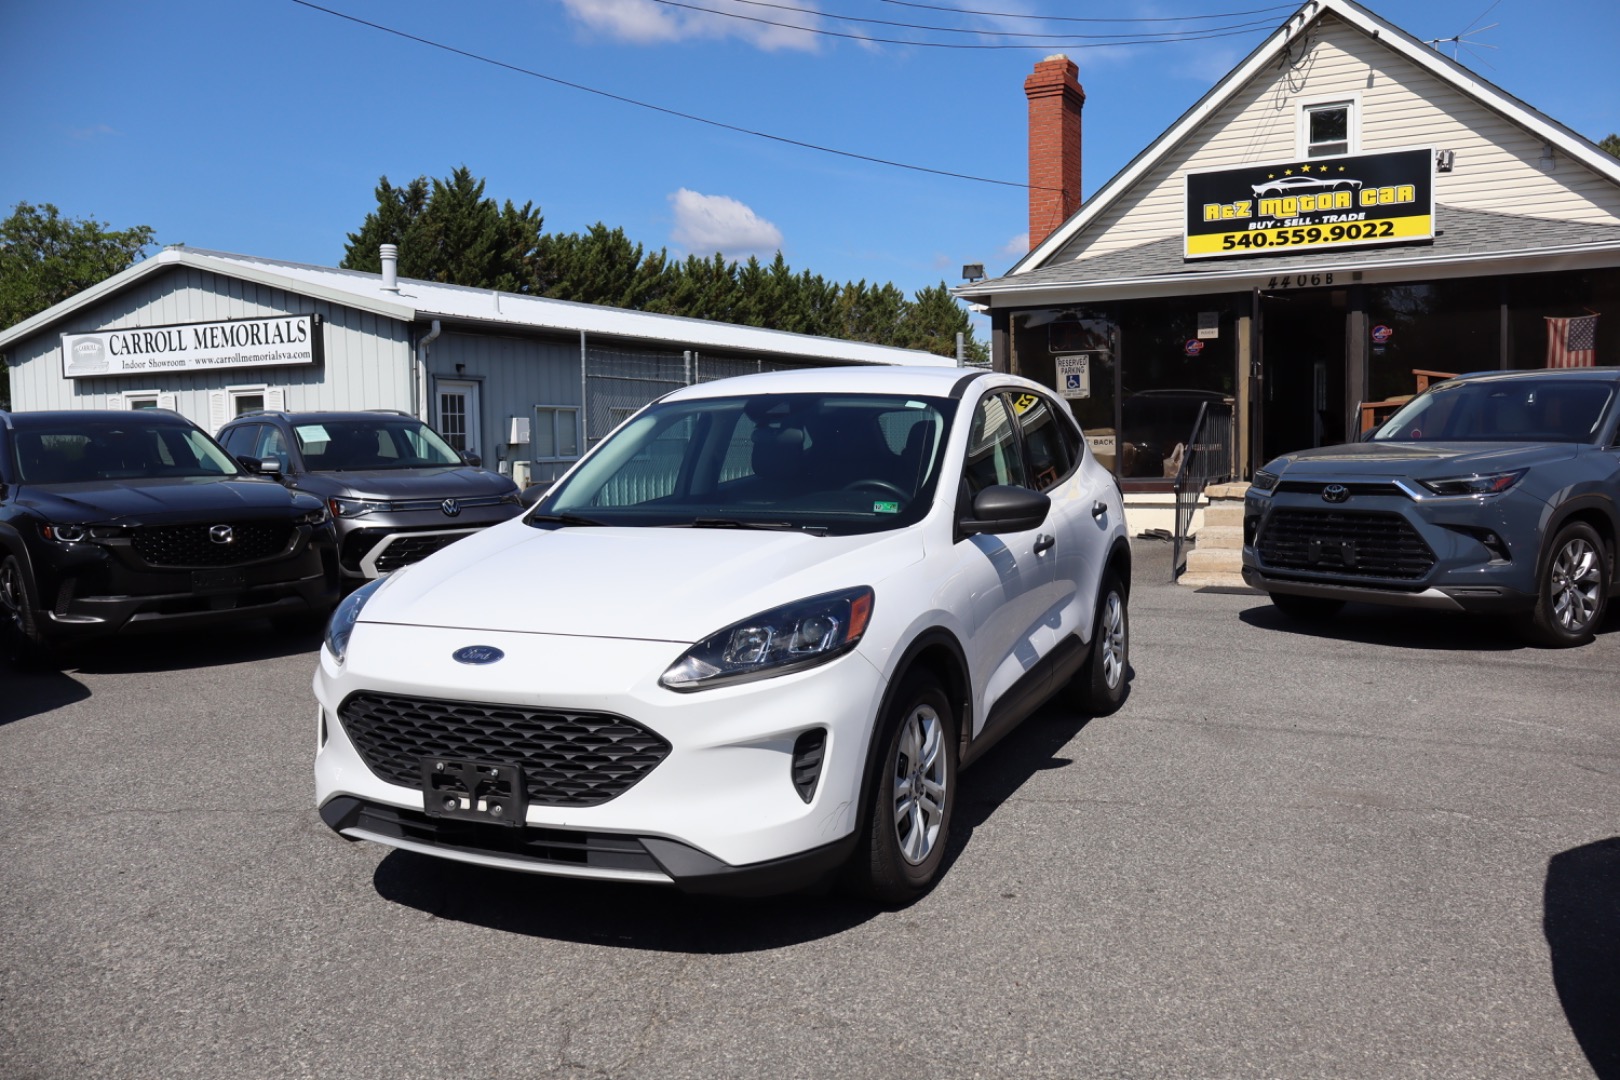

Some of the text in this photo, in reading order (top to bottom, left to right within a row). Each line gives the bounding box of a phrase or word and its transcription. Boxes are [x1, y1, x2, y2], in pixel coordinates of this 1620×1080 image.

[1203, 200, 1252, 222] R&Z
[1248, 212, 1366, 230] BUY SELL TRADE
[1222, 221, 1395, 250] 540.559.9022
[109, 319, 307, 356] CARROLL MEMORIALS
[122, 350, 311, 370] Indoor Showroom www.carrollmemorialsva.com
[1057, 358, 1088, 368] RESERVED
[1061, 366, 1085, 375] PARKING
[1093, 438, 1115, 446] BACK
[462, 648, 492, 660] Ford
